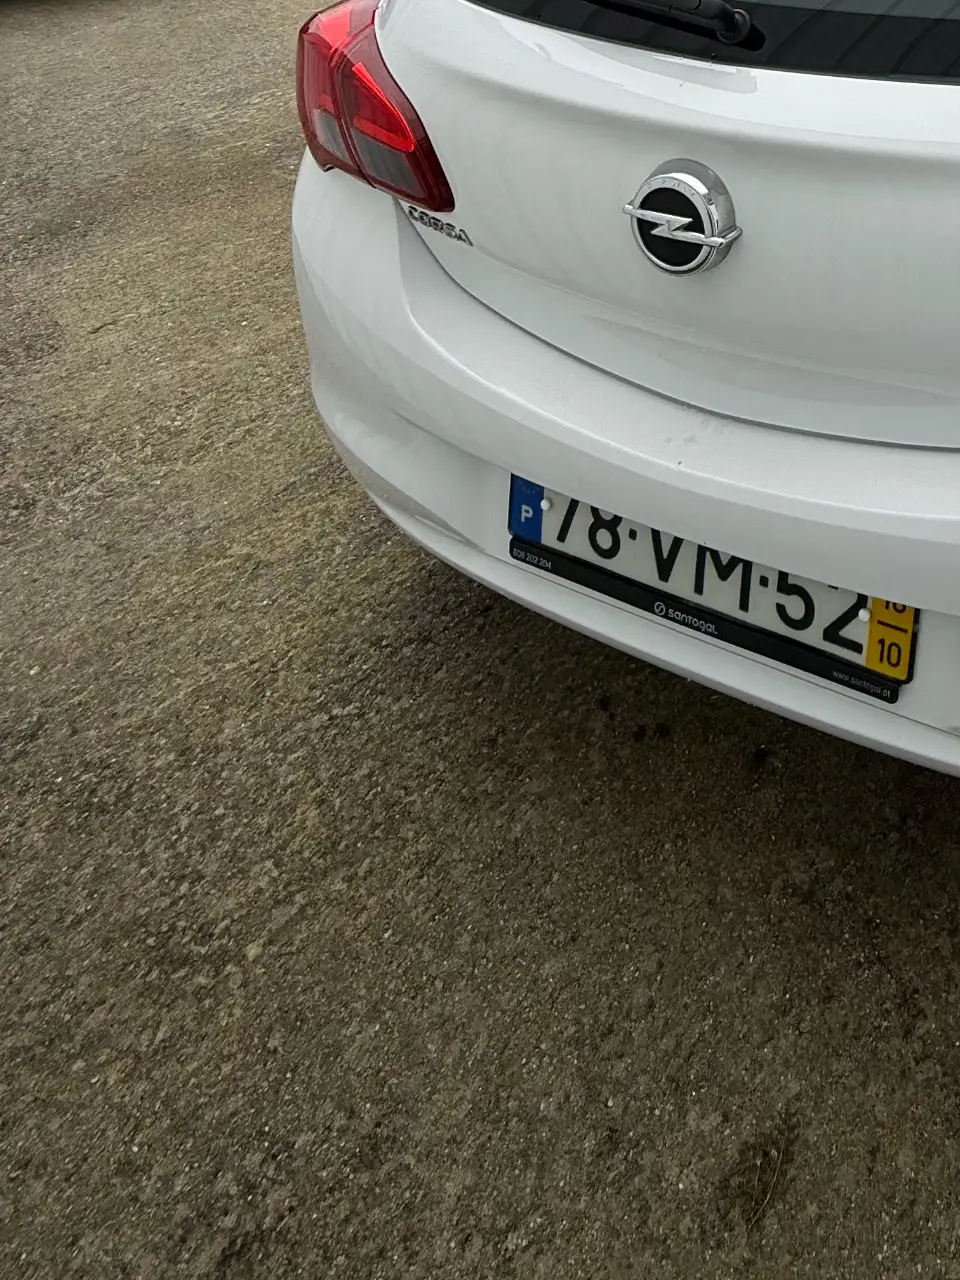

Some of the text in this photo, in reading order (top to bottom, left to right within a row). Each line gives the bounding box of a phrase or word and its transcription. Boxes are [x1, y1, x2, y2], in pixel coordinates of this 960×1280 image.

[408, 205, 473, 246] CORSA
[520, 504, 534, 523] P
[667, 606, 718, 635] santogal
[878, 637, 902, 668] 10
